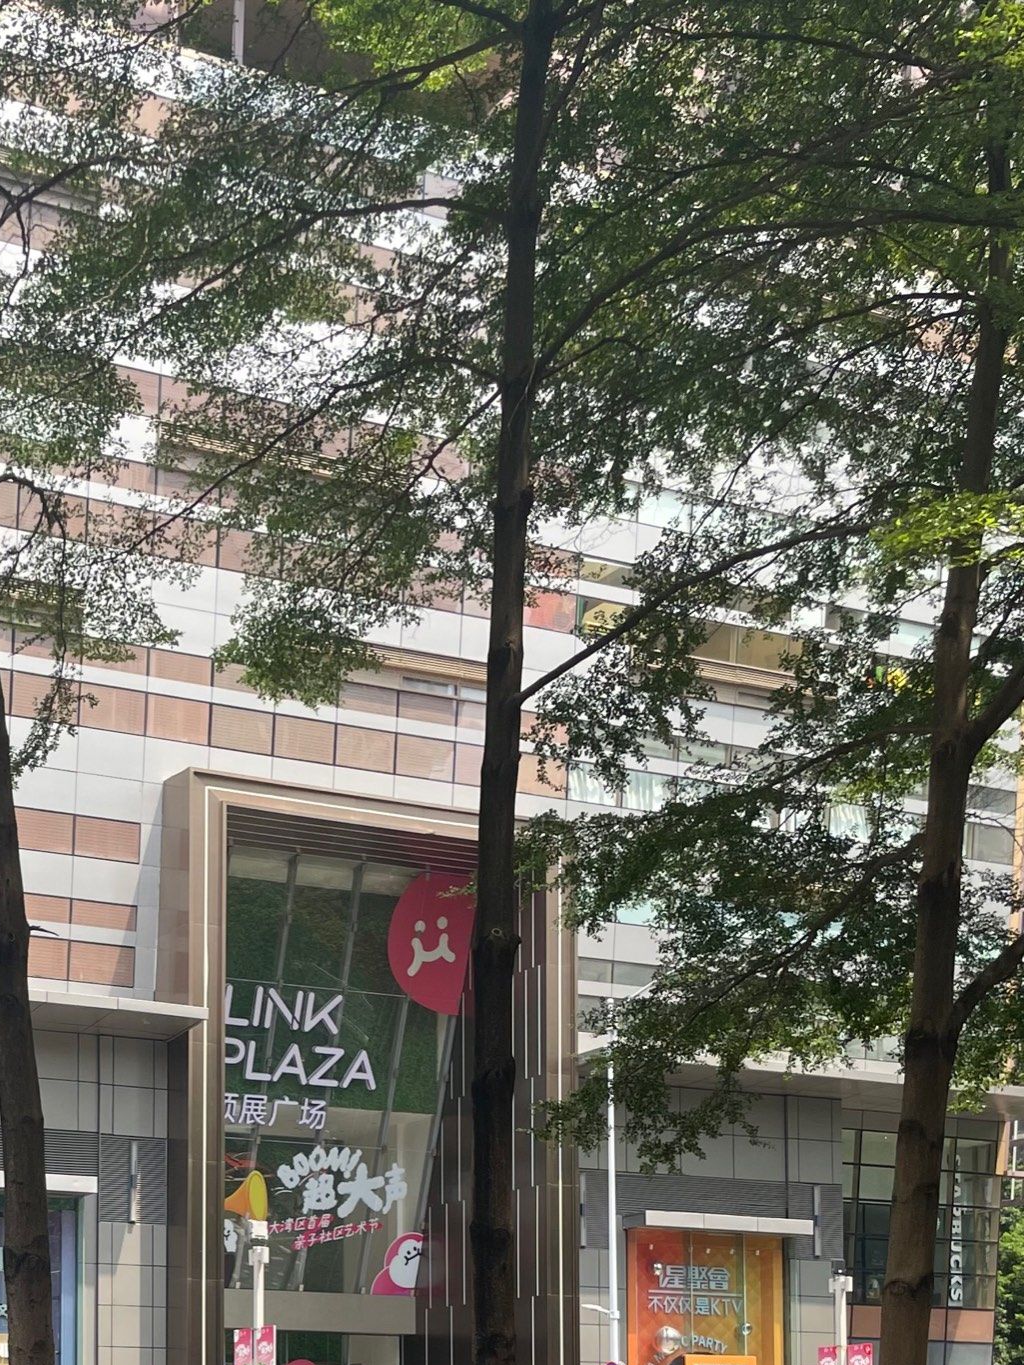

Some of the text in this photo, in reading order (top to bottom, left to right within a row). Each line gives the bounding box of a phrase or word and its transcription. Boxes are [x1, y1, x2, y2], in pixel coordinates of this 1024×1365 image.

[225, 984, 344, 1035] LINK
[225, 1036, 376, 1091] PLAZA
[302, 1163, 407, 1219] 超大声
[269, 1213, 332, 1235] 大湾区首届
[294, 1218, 379, 1251] 亲子社区艺术节
[692, 1335, 728, 1354] PARTY
